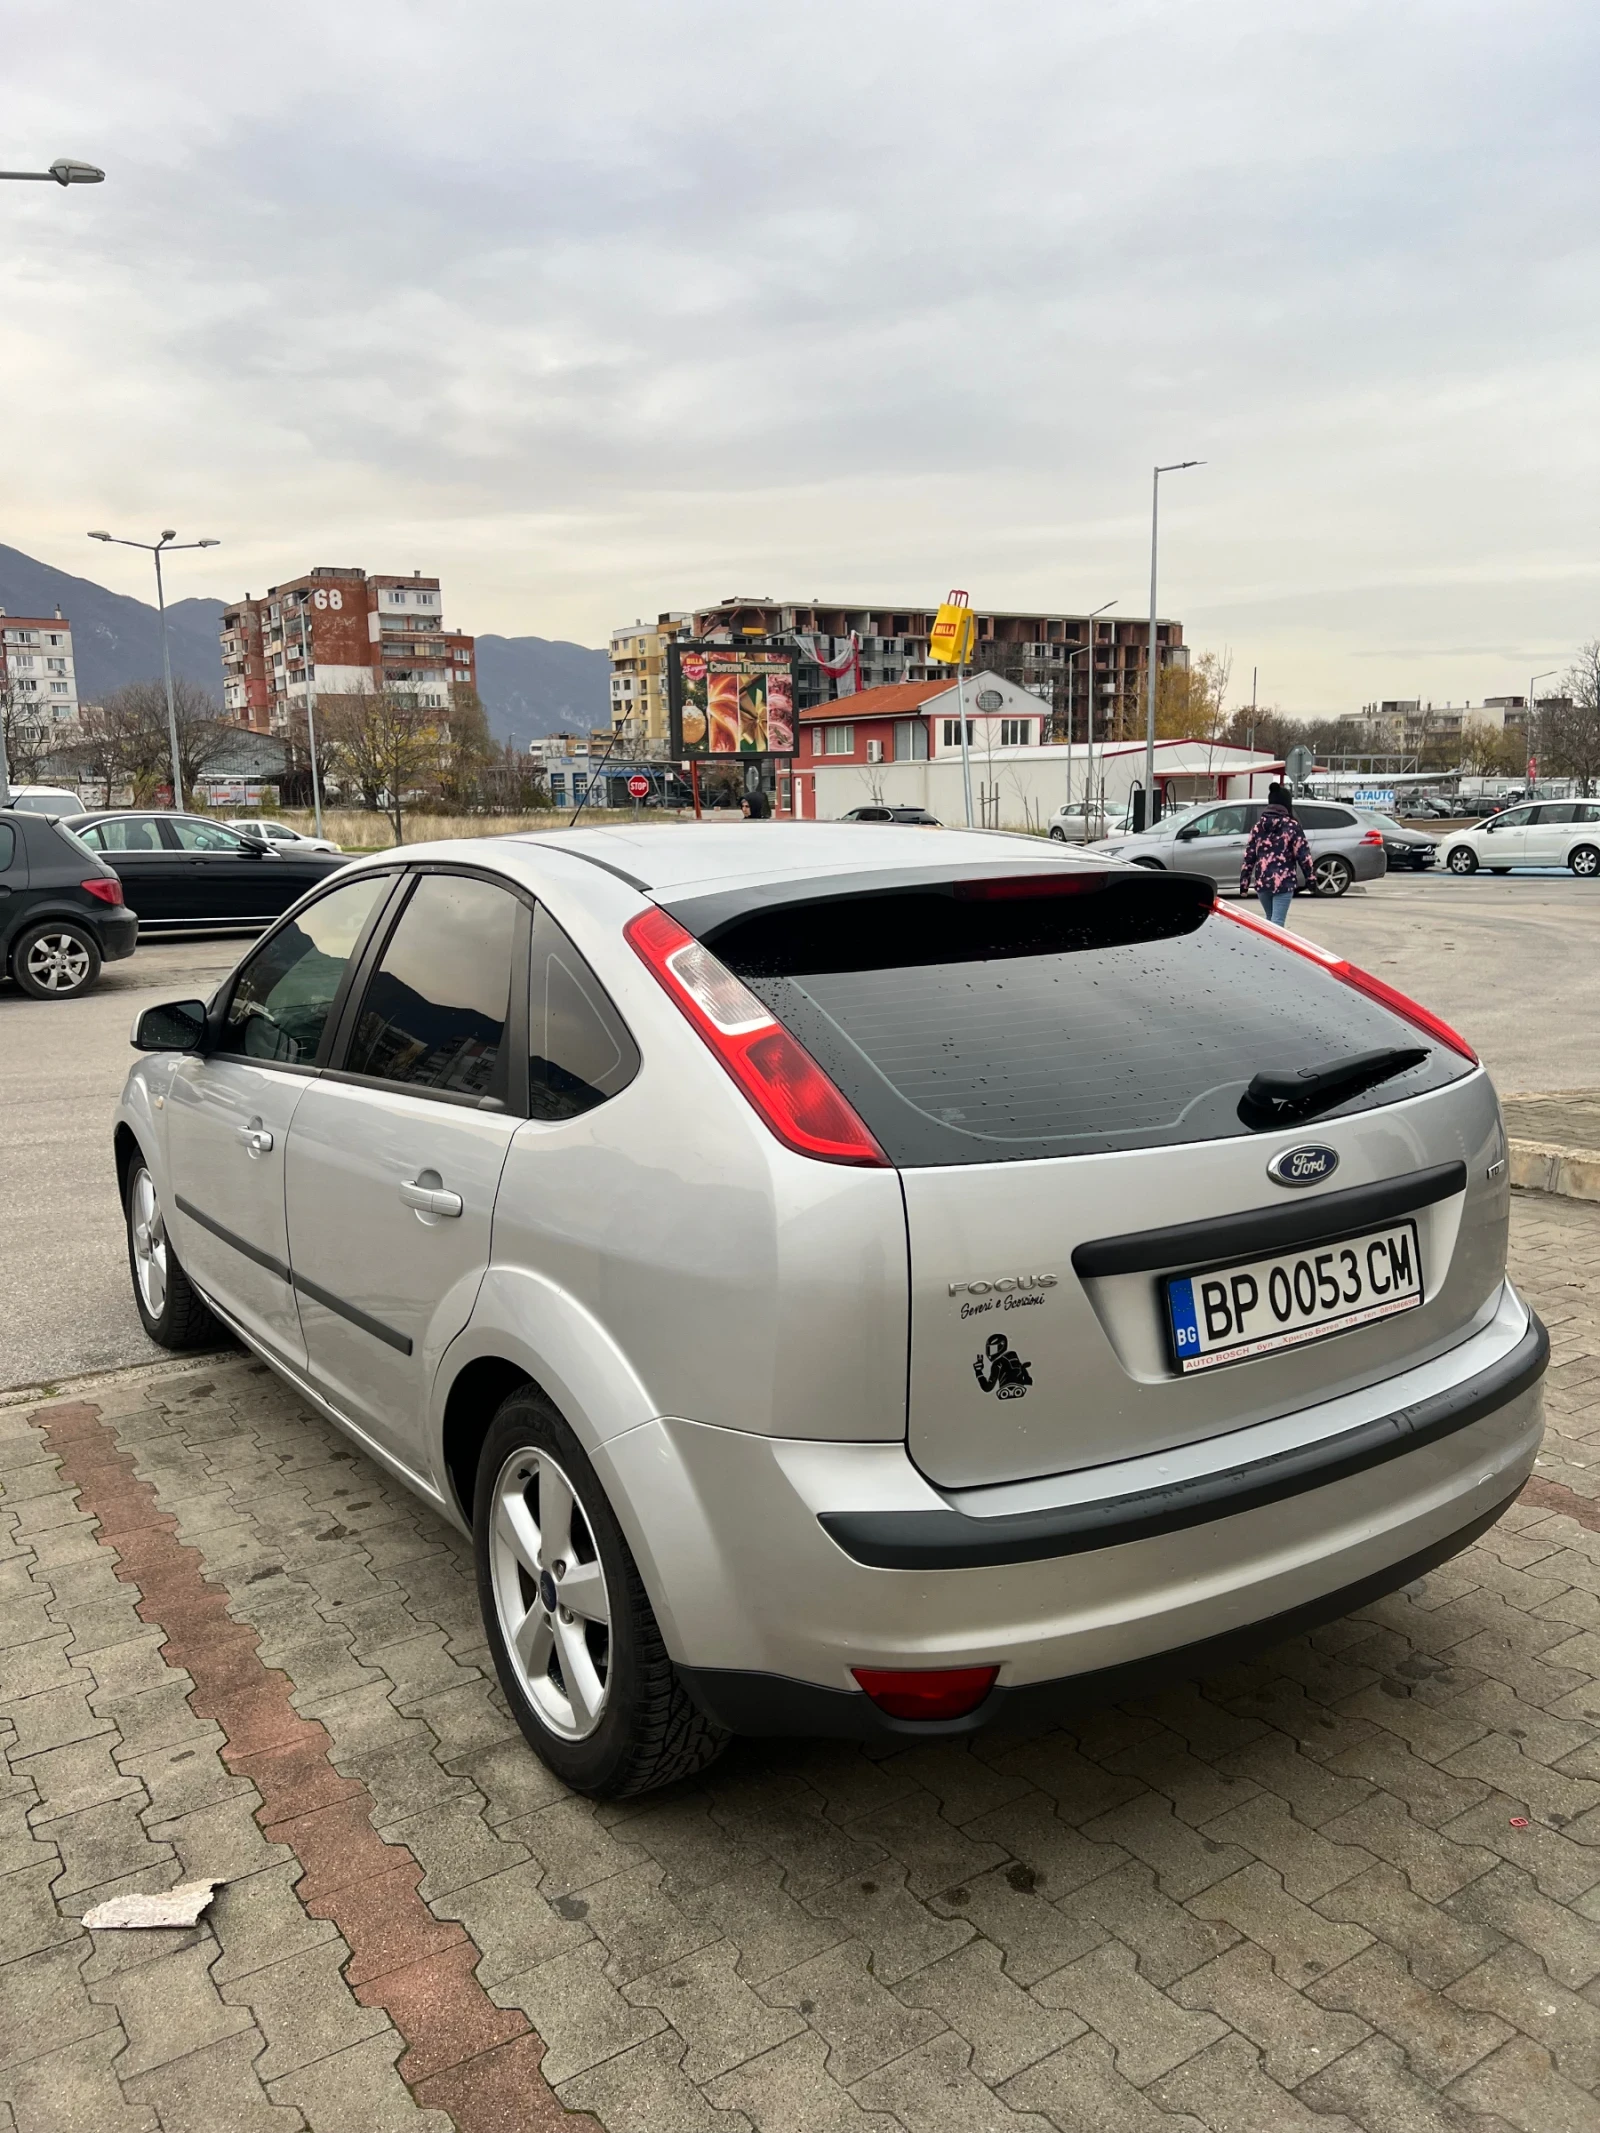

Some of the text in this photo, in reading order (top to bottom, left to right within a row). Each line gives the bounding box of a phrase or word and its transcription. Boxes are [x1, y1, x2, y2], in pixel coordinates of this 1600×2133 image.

[314, 588, 343, 610] 68
[935, 625, 954, 635] BILLA
[630, 782, 647, 791] STOP
[1291, 1152, 1327, 1177] Ford
[948, 1273, 1058, 1298] FOCUS
[1201, 1234, 1414, 1341] BP 0053 CM
[1176, 1326, 1197, 1346] BG
[1186, 1356, 1213, 1369] AUTO
[1216, 1346, 1250, 1361] BOSCH
[1345, 1316, 1358, 1325] 194
